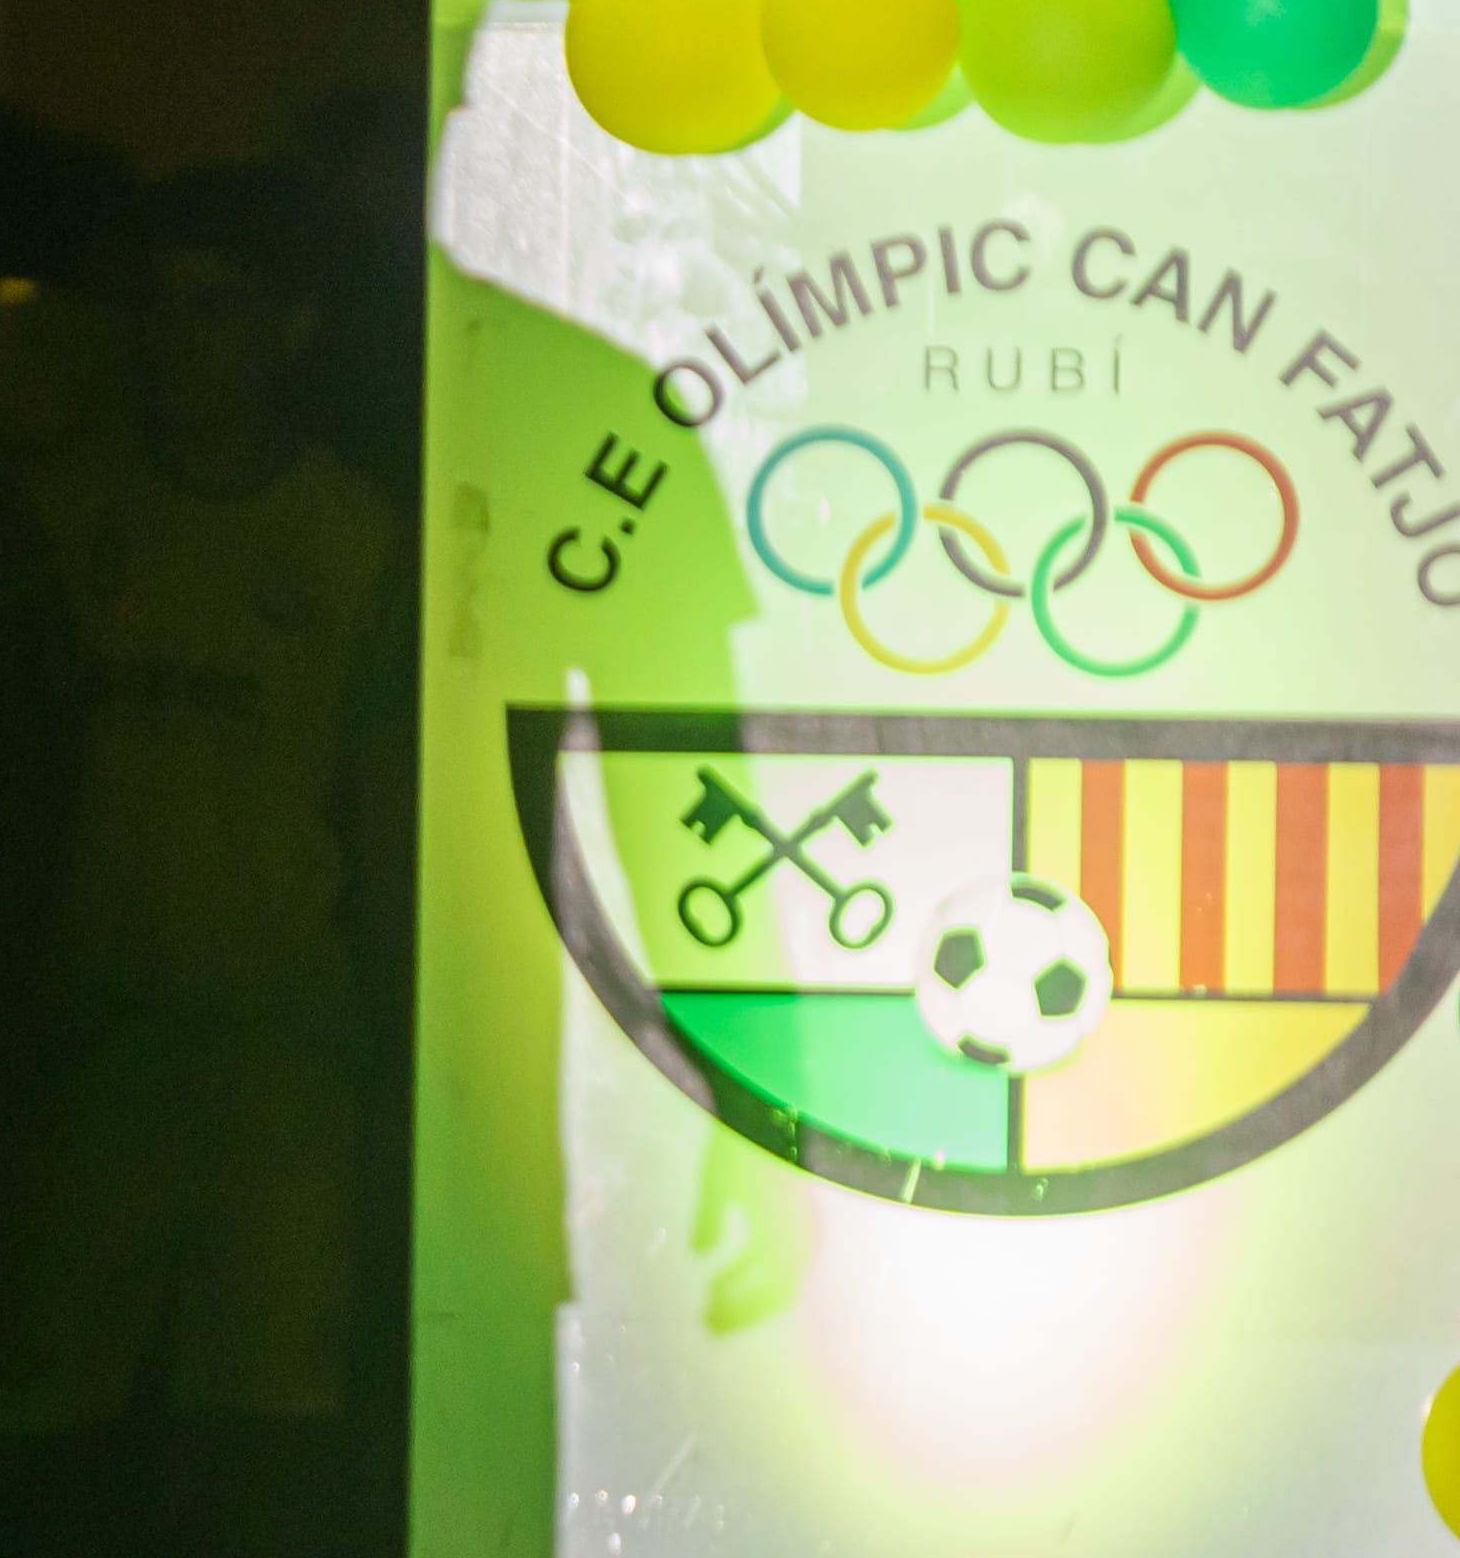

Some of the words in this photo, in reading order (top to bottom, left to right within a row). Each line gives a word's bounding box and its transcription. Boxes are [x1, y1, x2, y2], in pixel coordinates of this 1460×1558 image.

[547, 431, 669, 595] C.E
[652, 218, 1032, 429] OLÍMPIC
[1071, 226, 1277, 355] CAN
[923, 333, 1122, 394] RUBÍ
